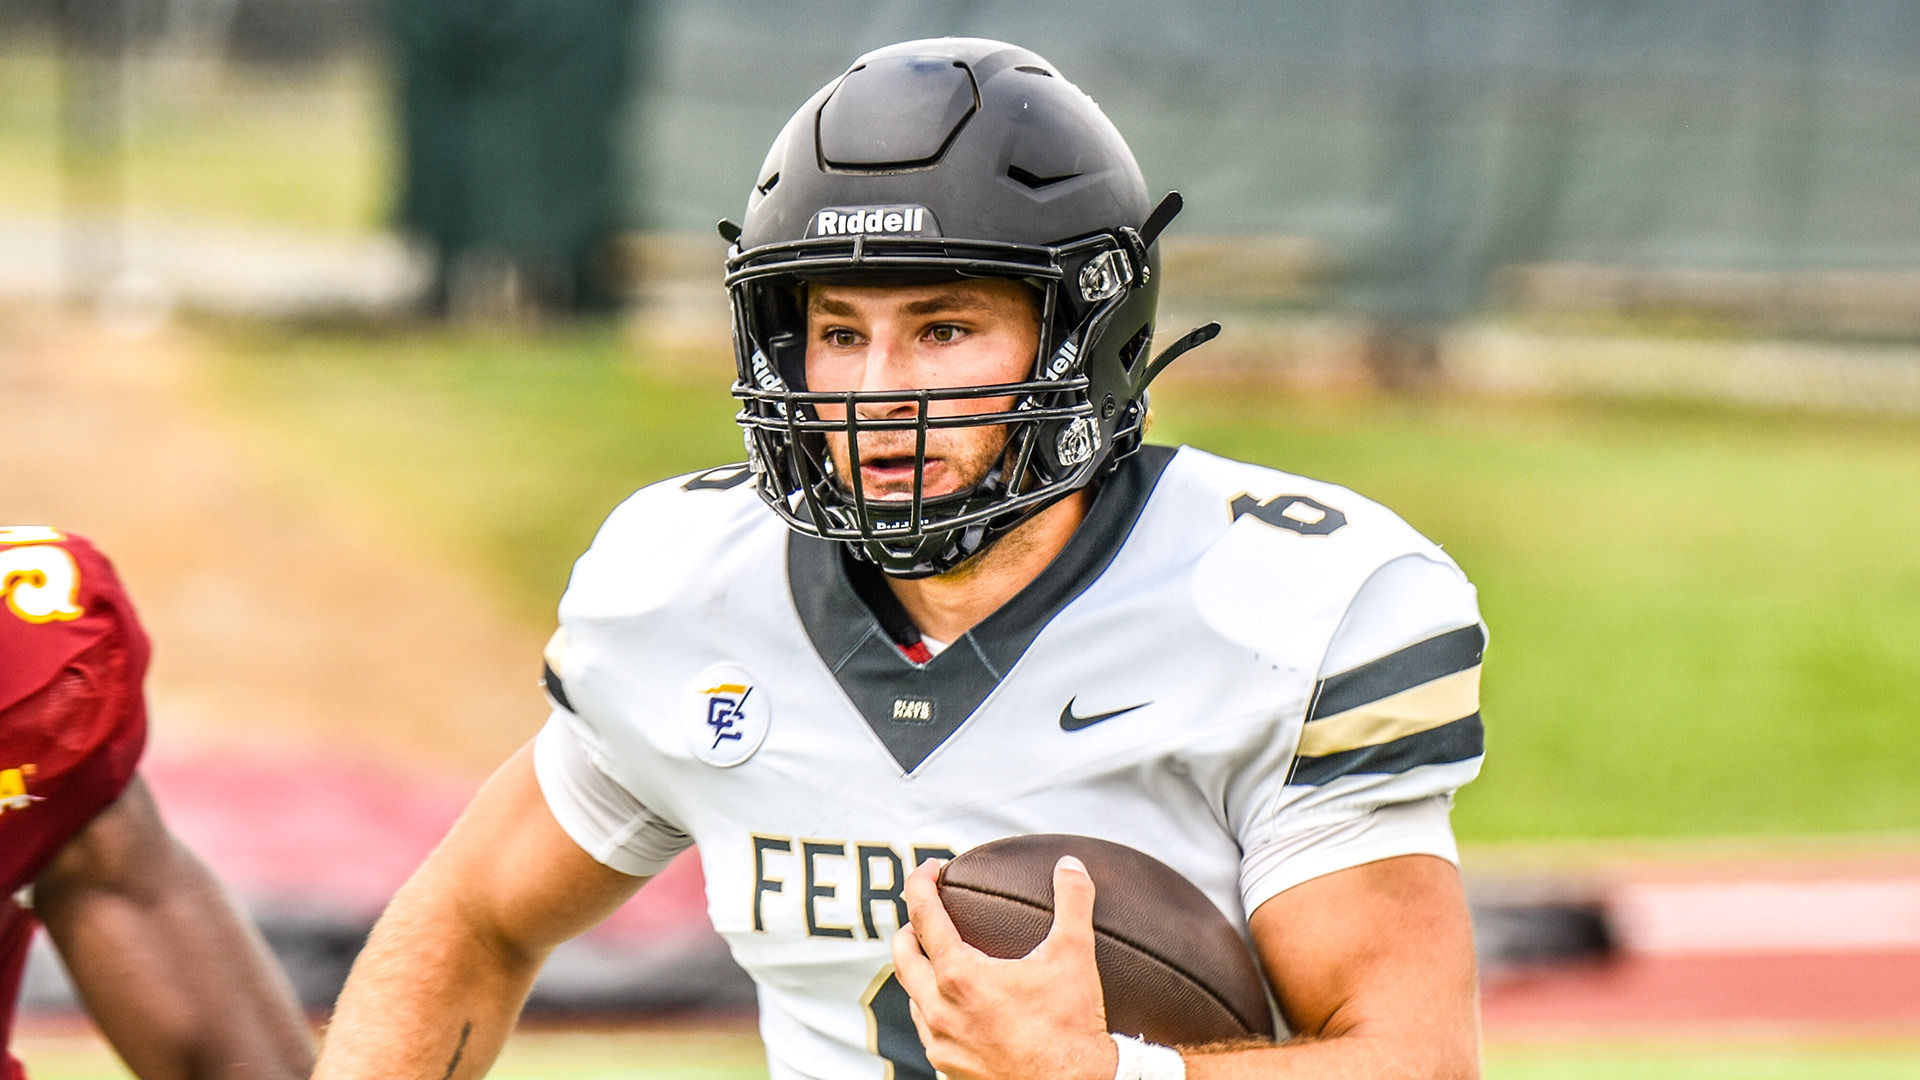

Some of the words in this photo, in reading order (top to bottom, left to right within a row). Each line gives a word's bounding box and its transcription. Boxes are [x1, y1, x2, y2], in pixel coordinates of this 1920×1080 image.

[817, 208, 924, 236] Riddell
[1226, 490, 1349, 537] 6
[750, 832, 957, 941] FER
